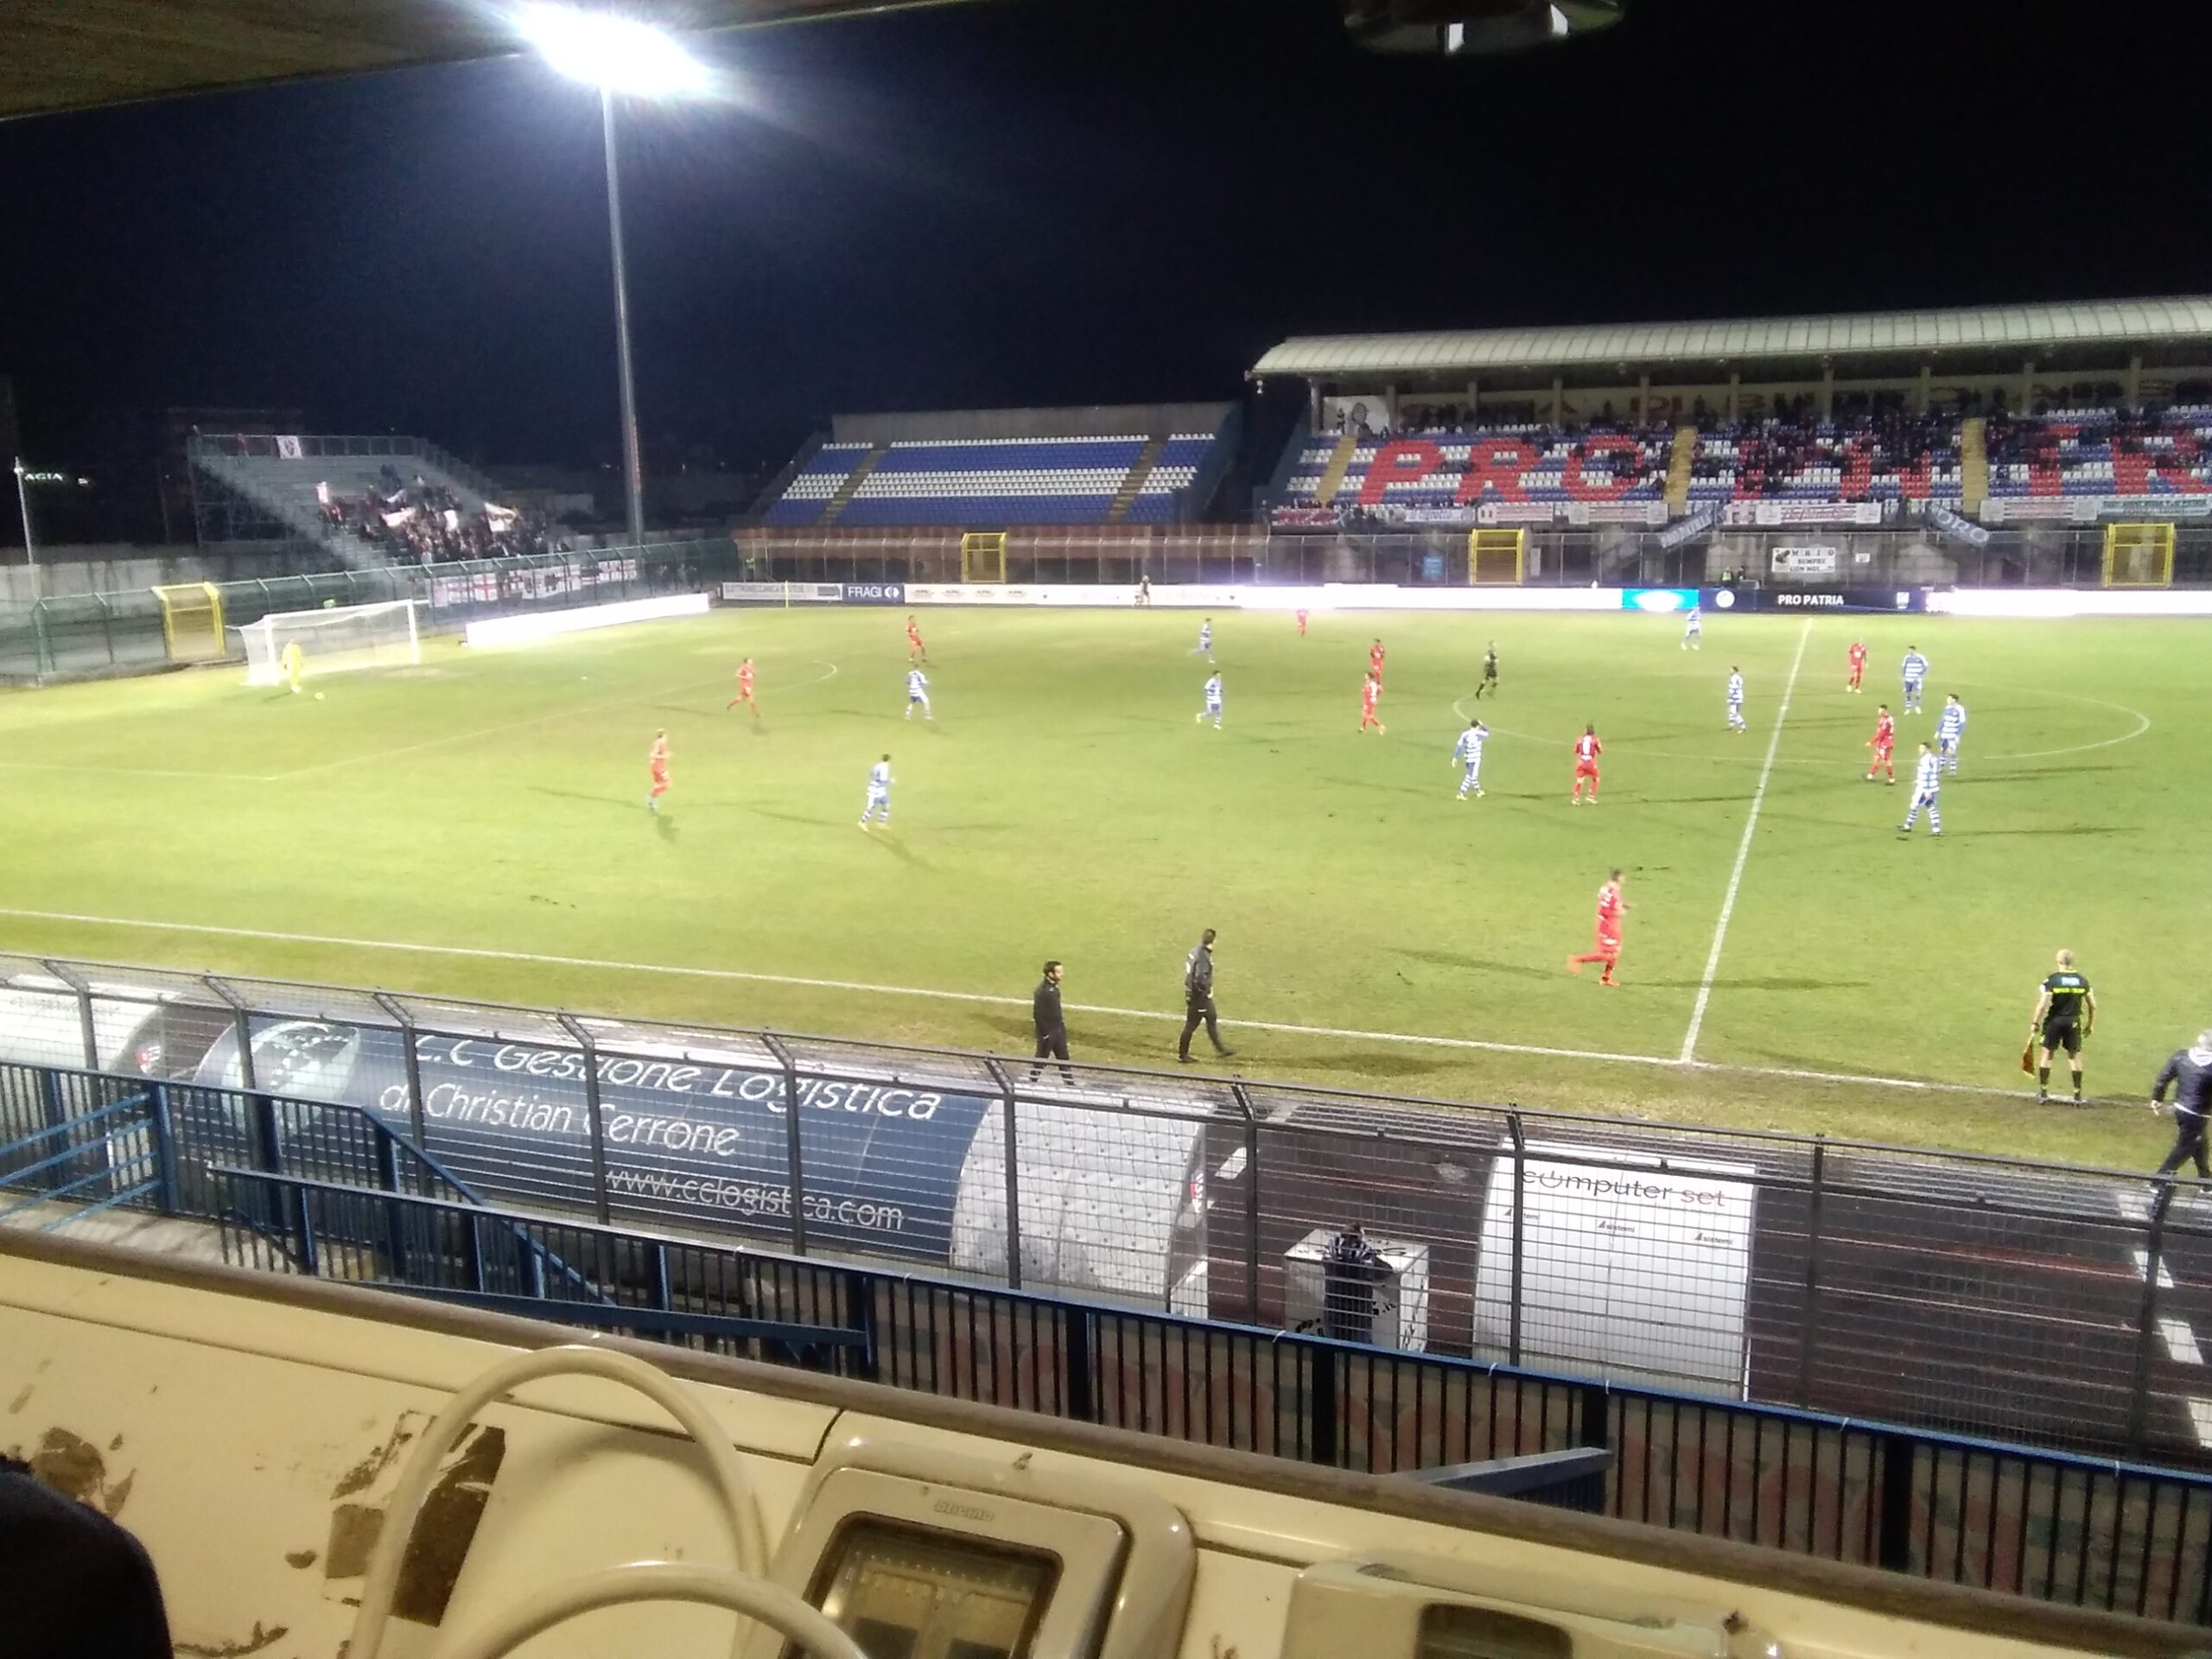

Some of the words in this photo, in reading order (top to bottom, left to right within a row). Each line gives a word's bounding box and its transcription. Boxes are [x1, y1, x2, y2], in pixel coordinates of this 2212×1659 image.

[848, 587, 882, 598] FRAGI
[1778, 594, 1802, 605] PRO
[1802, 594, 1844, 605] PATRIA
[427, 1084, 572, 1133] Christian
[1522, 1170, 1673, 1200] computer
[1681, 1188, 1726, 1208] set
[605, 1169, 904, 1230] www.cclogistca.com
[1605, 1224, 1636, 1234] sistemi
[1703, 1235, 1733, 1245] sistemi
